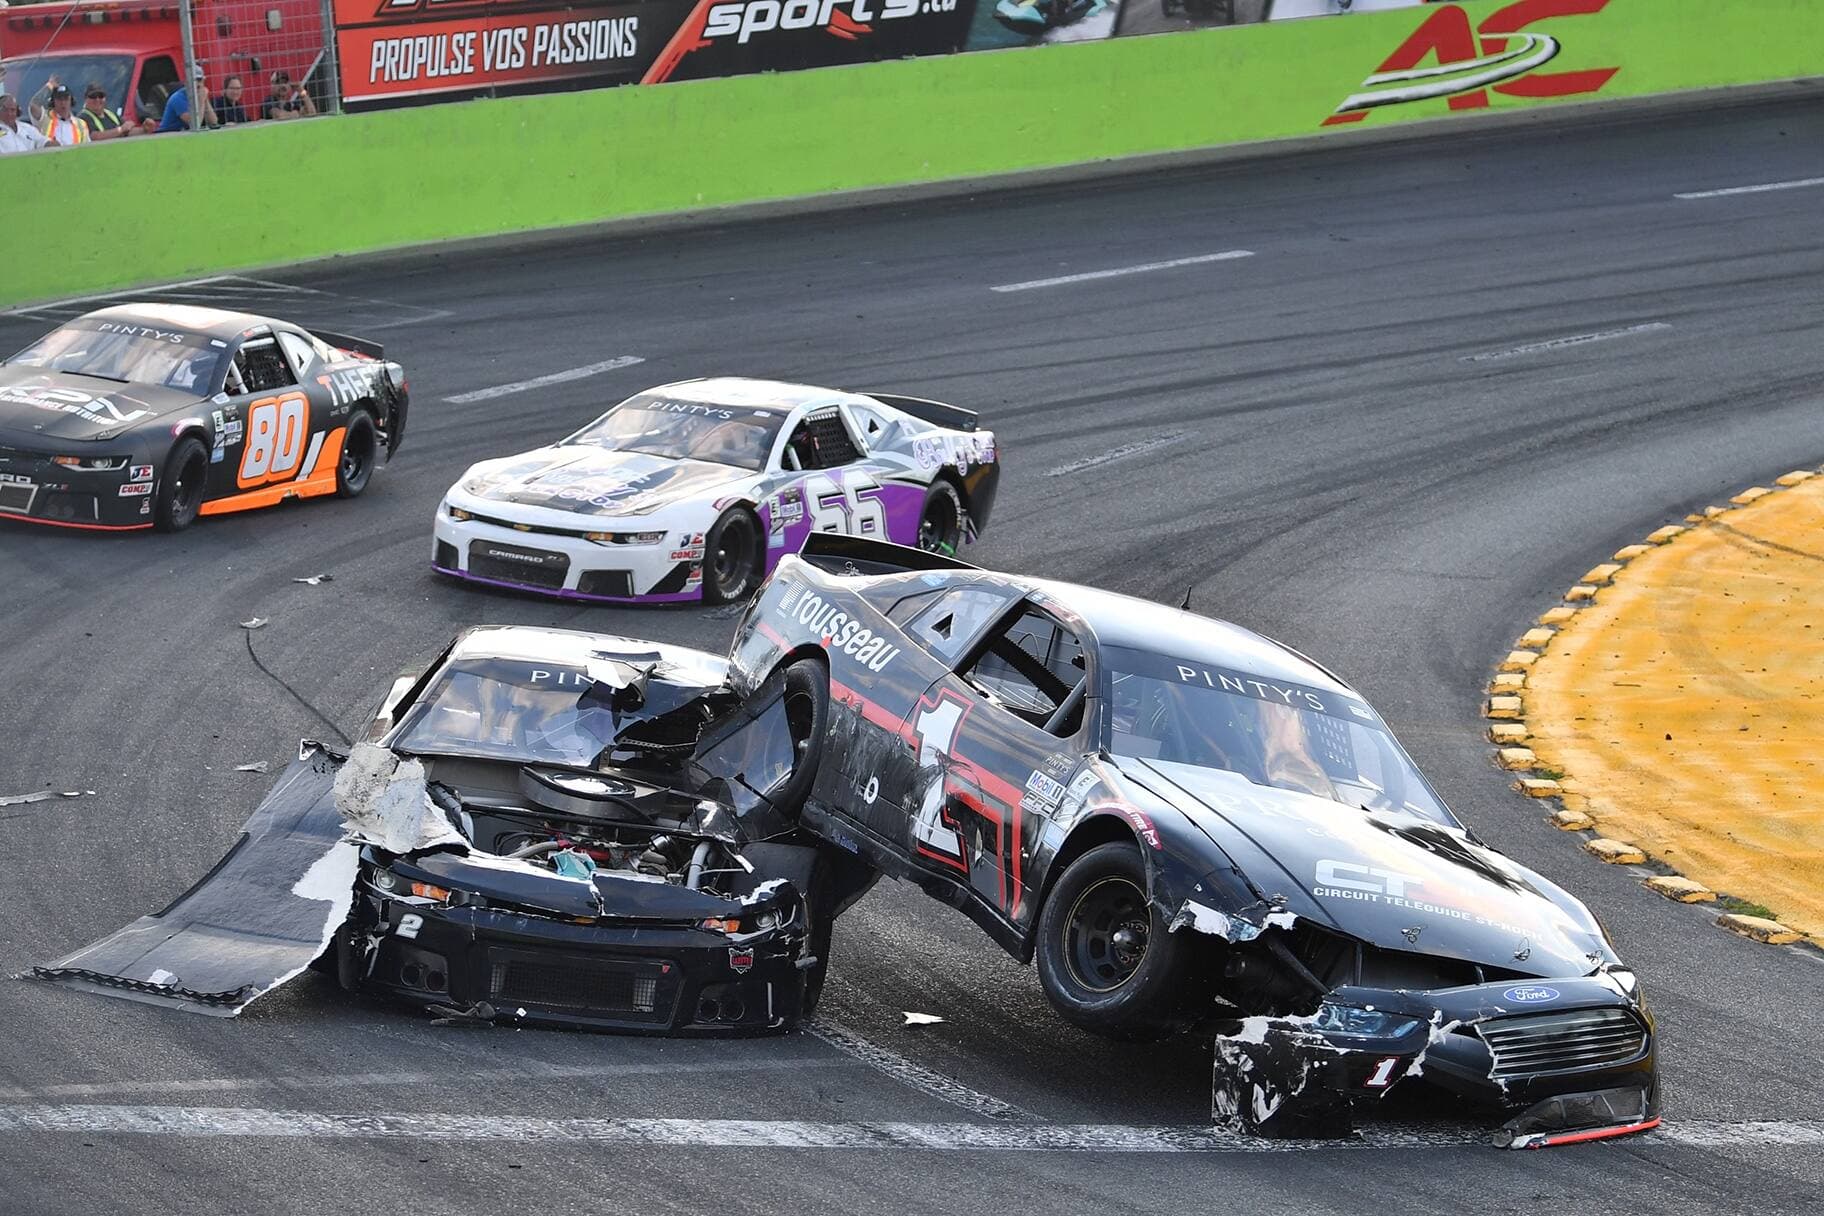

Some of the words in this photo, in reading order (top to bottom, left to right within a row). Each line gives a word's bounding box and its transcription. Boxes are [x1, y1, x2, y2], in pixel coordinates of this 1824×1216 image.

[369, 32, 476, 83] PROPULSE
[482, 27, 527, 72] VOS
[532, 17, 639, 66] PASSIONS
[98, 323, 184, 343] PINTY'S
[647, 401, 733, 419] PINTY'S
[239, 393, 307, 485] 80
[804, 467, 889, 541] 66
[488, 549, 543, 563] CAMARO
[670, 550, 697, 559] COMP
[792, 589, 901, 672] rousseau
[1176, 665, 1327, 713] PINTY'S
[1031, 772, 1054, 796] Mobil
[1313, 887, 1379, 902] CIRCUIT
[1384, 896, 1472, 921] TELEGUIDE
[395, 913, 423, 939] 2
[1513, 987, 1551, 1001] Ford
[1365, 1057, 1398, 1086] 1
